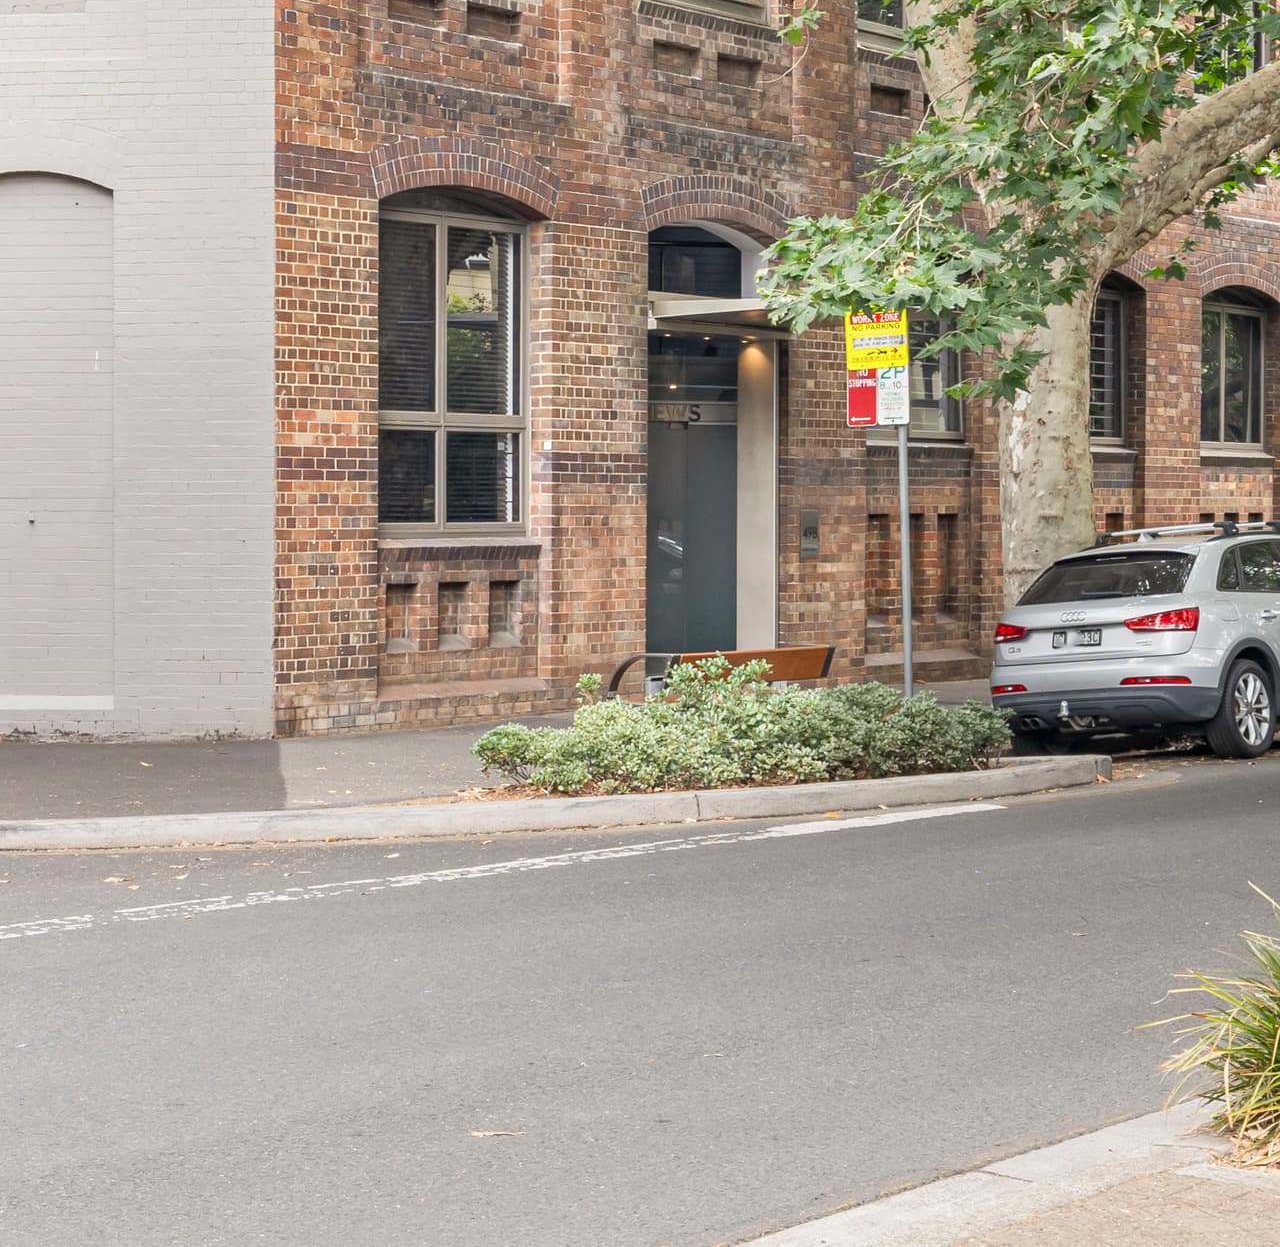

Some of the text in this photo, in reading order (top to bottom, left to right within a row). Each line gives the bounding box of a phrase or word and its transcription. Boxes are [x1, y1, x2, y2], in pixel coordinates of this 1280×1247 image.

[880, 312, 900, 322] ZONE
[866, 322, 900, 331] PARKING
[881, 365, 906, 379] 2P
[849, 378, 876, 388] STOPPING
